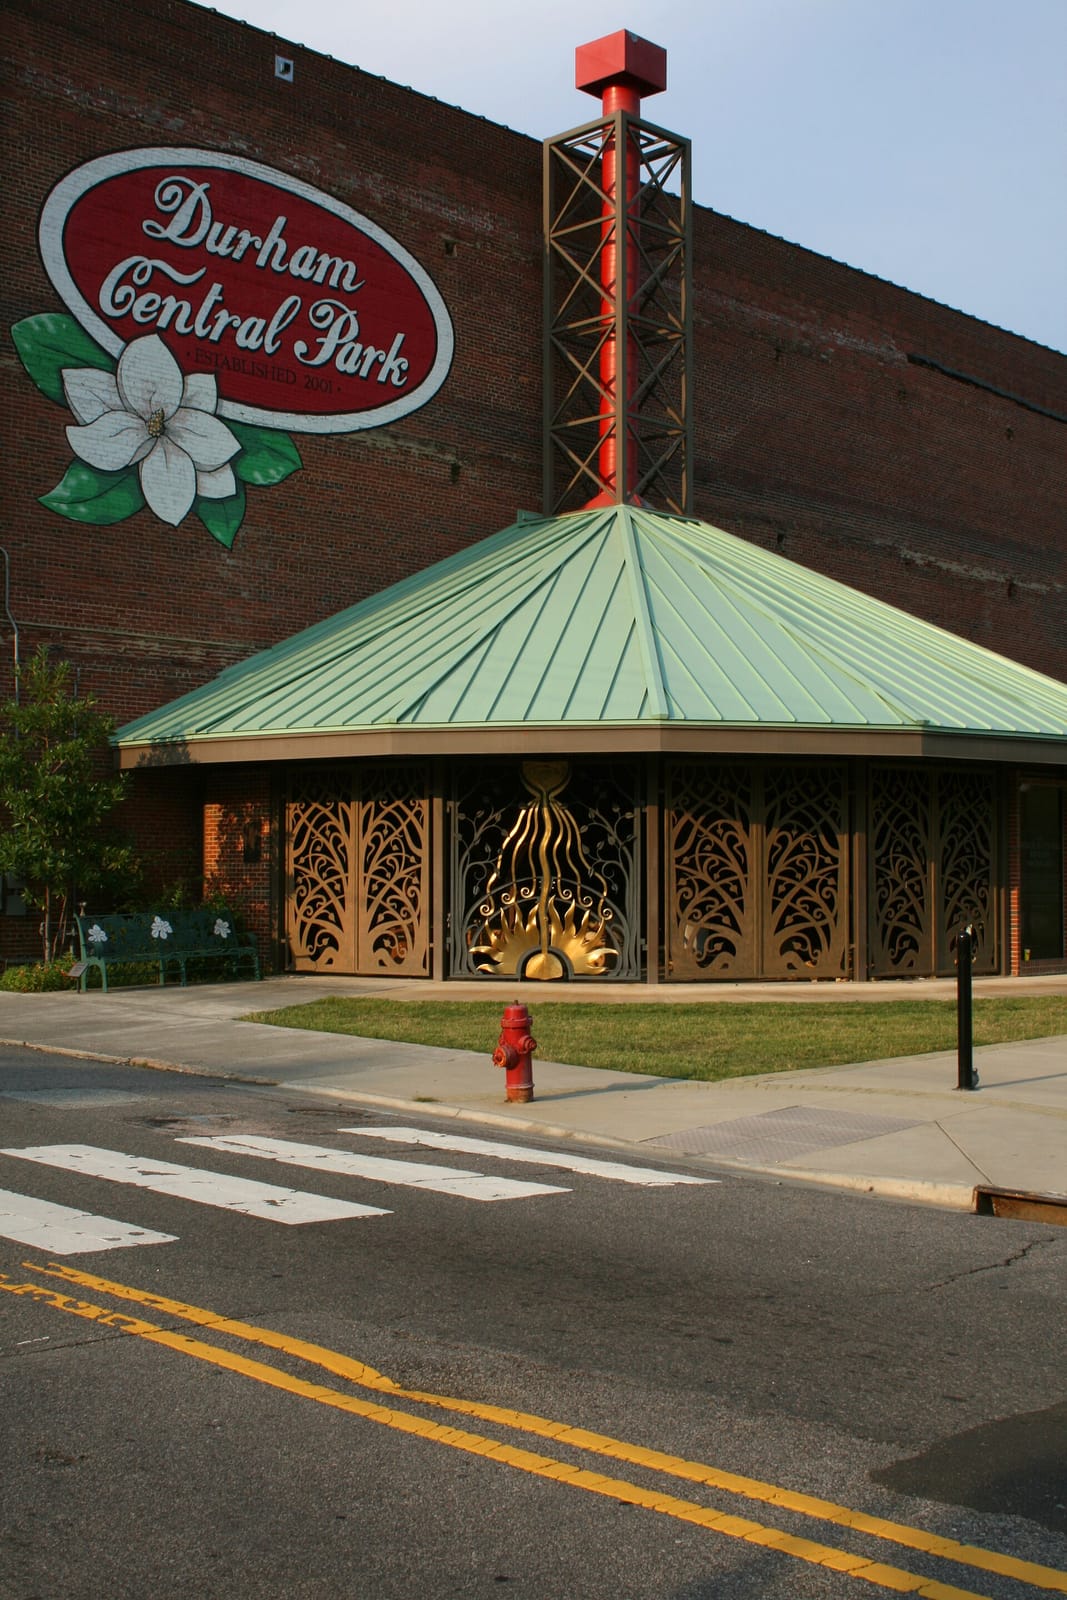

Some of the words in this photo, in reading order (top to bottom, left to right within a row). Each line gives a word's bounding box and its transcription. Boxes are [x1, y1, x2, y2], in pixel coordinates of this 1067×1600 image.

[142, 175, 365, 293] Durham
[99, 256, 301, 353] Central
[293, 298, 409, 387] Park
[194, 349, 297, 385] ESTABLISHED
[304, 374, 332, 394] 2001
